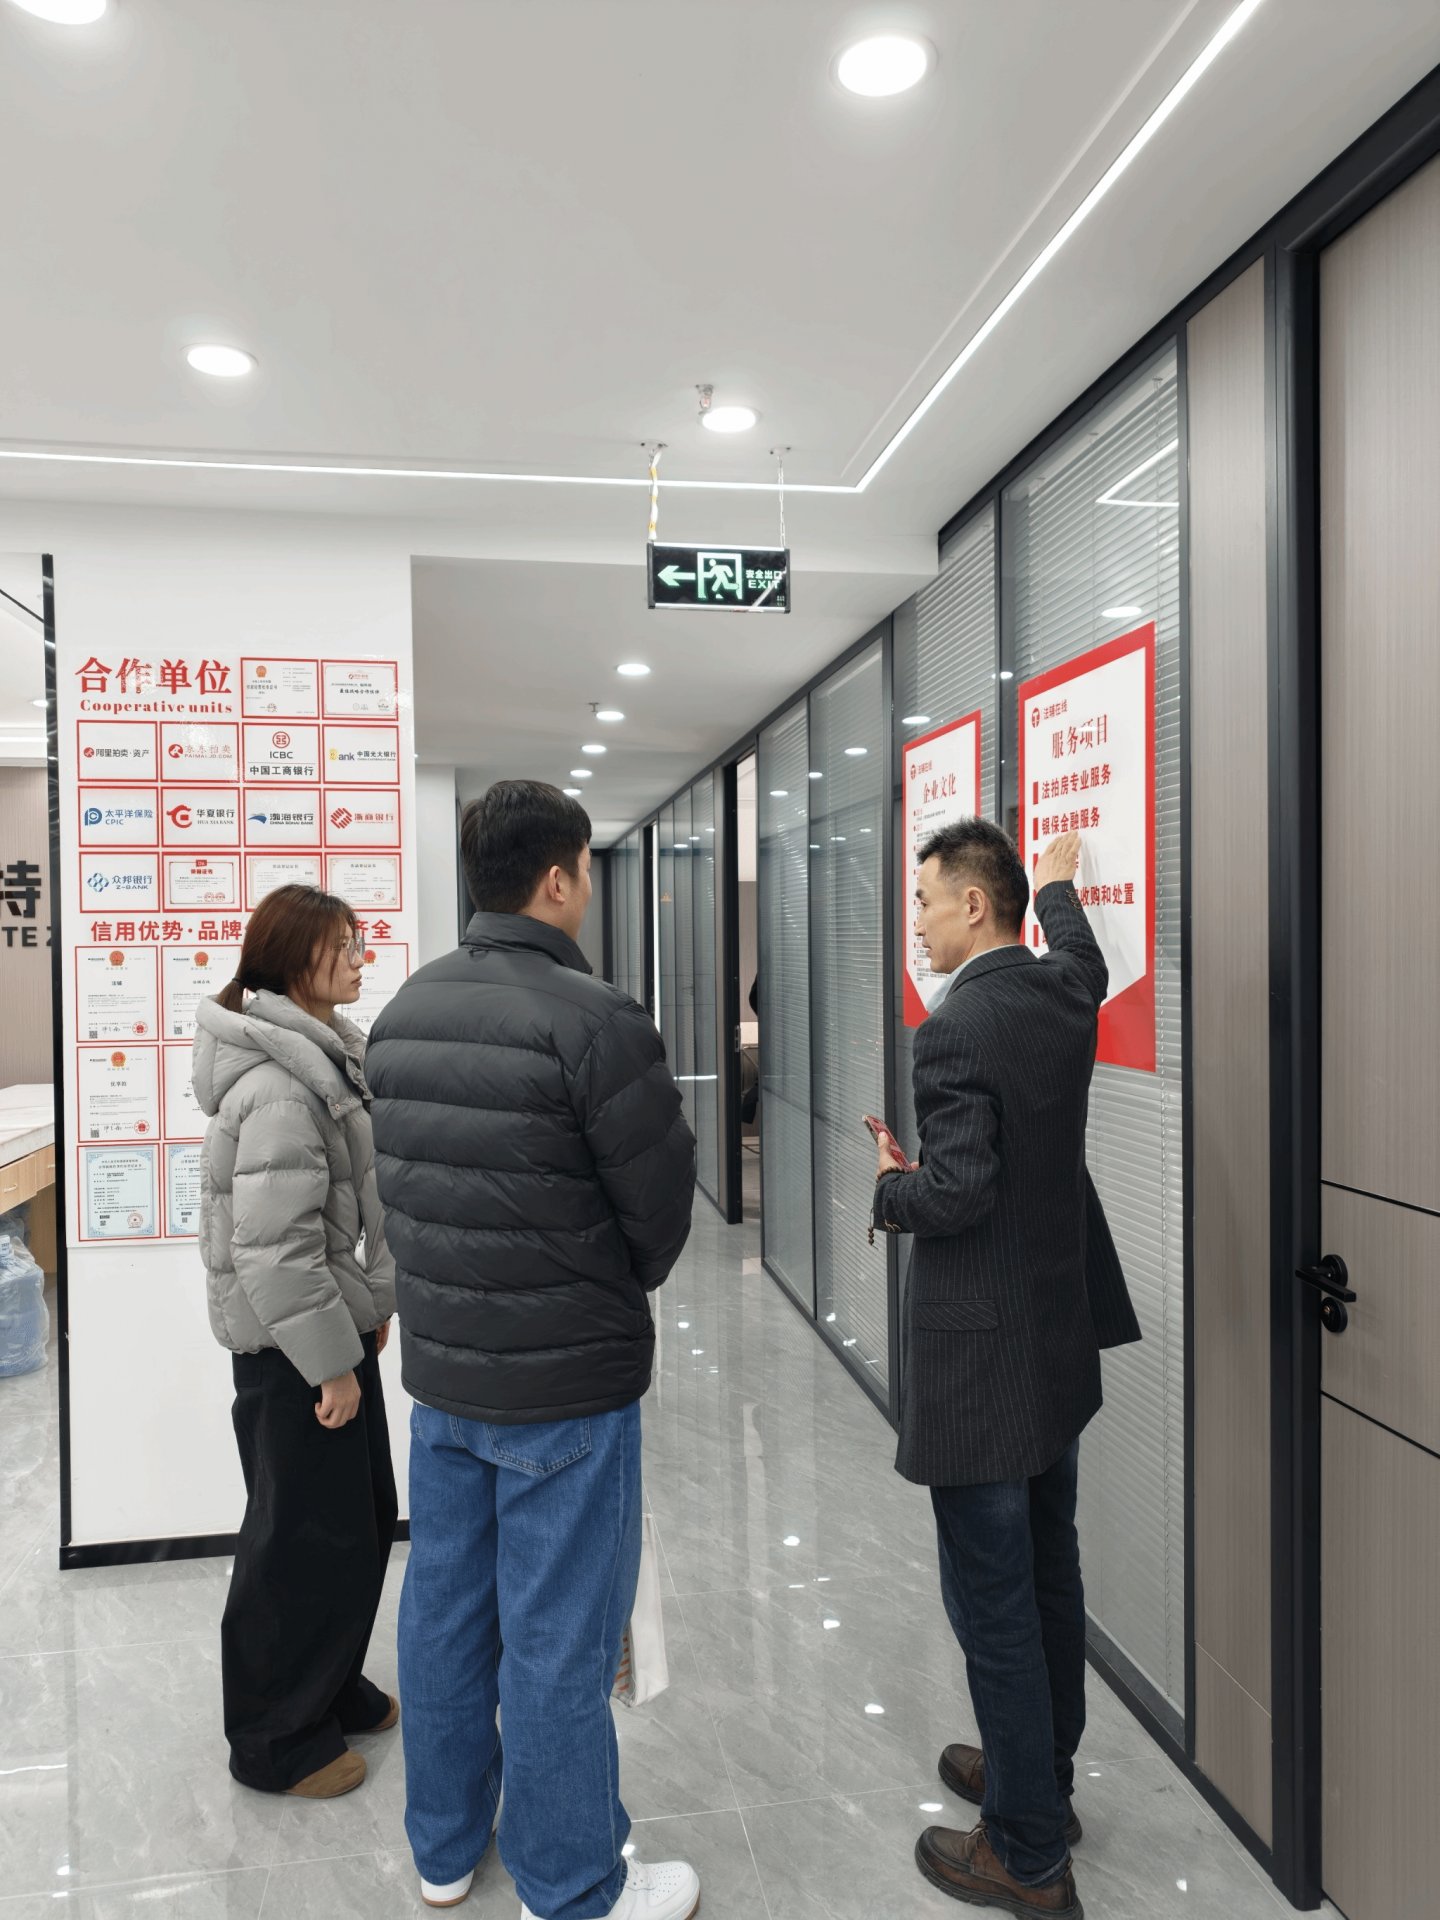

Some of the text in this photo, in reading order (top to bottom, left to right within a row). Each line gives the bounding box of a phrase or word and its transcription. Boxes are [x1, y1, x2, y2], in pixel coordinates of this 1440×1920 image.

[745, 569, 783, 579] 安全出口
[748, 579, 780, 589] EXIT
[75, 656, 232, 695] 合作单位
[80, 699, 233, 715] Cooperative units
[1052, 714, 1108, 759] 服务项目
[269, 751, 294, 759] ICBC
[356, 750, 396, 758] 中国光大银行
[249, 765, 314, 776] 中国工商银行
[1041, 763, 1112, 800] 法拍房专业服务
[923, 772, 957, 804] 企业文化
[105, 809, 153, 819] 太平洋保险
[196, 808, 235, 818] 华夏银行
[269, 813, 314, 821] 渤海银行
[1041, 806, 1100, 835] 银保金融服务
[111, 875, 152, 885] 众邦银行
[91, 920, 242, 942] 信用优势·品牌
